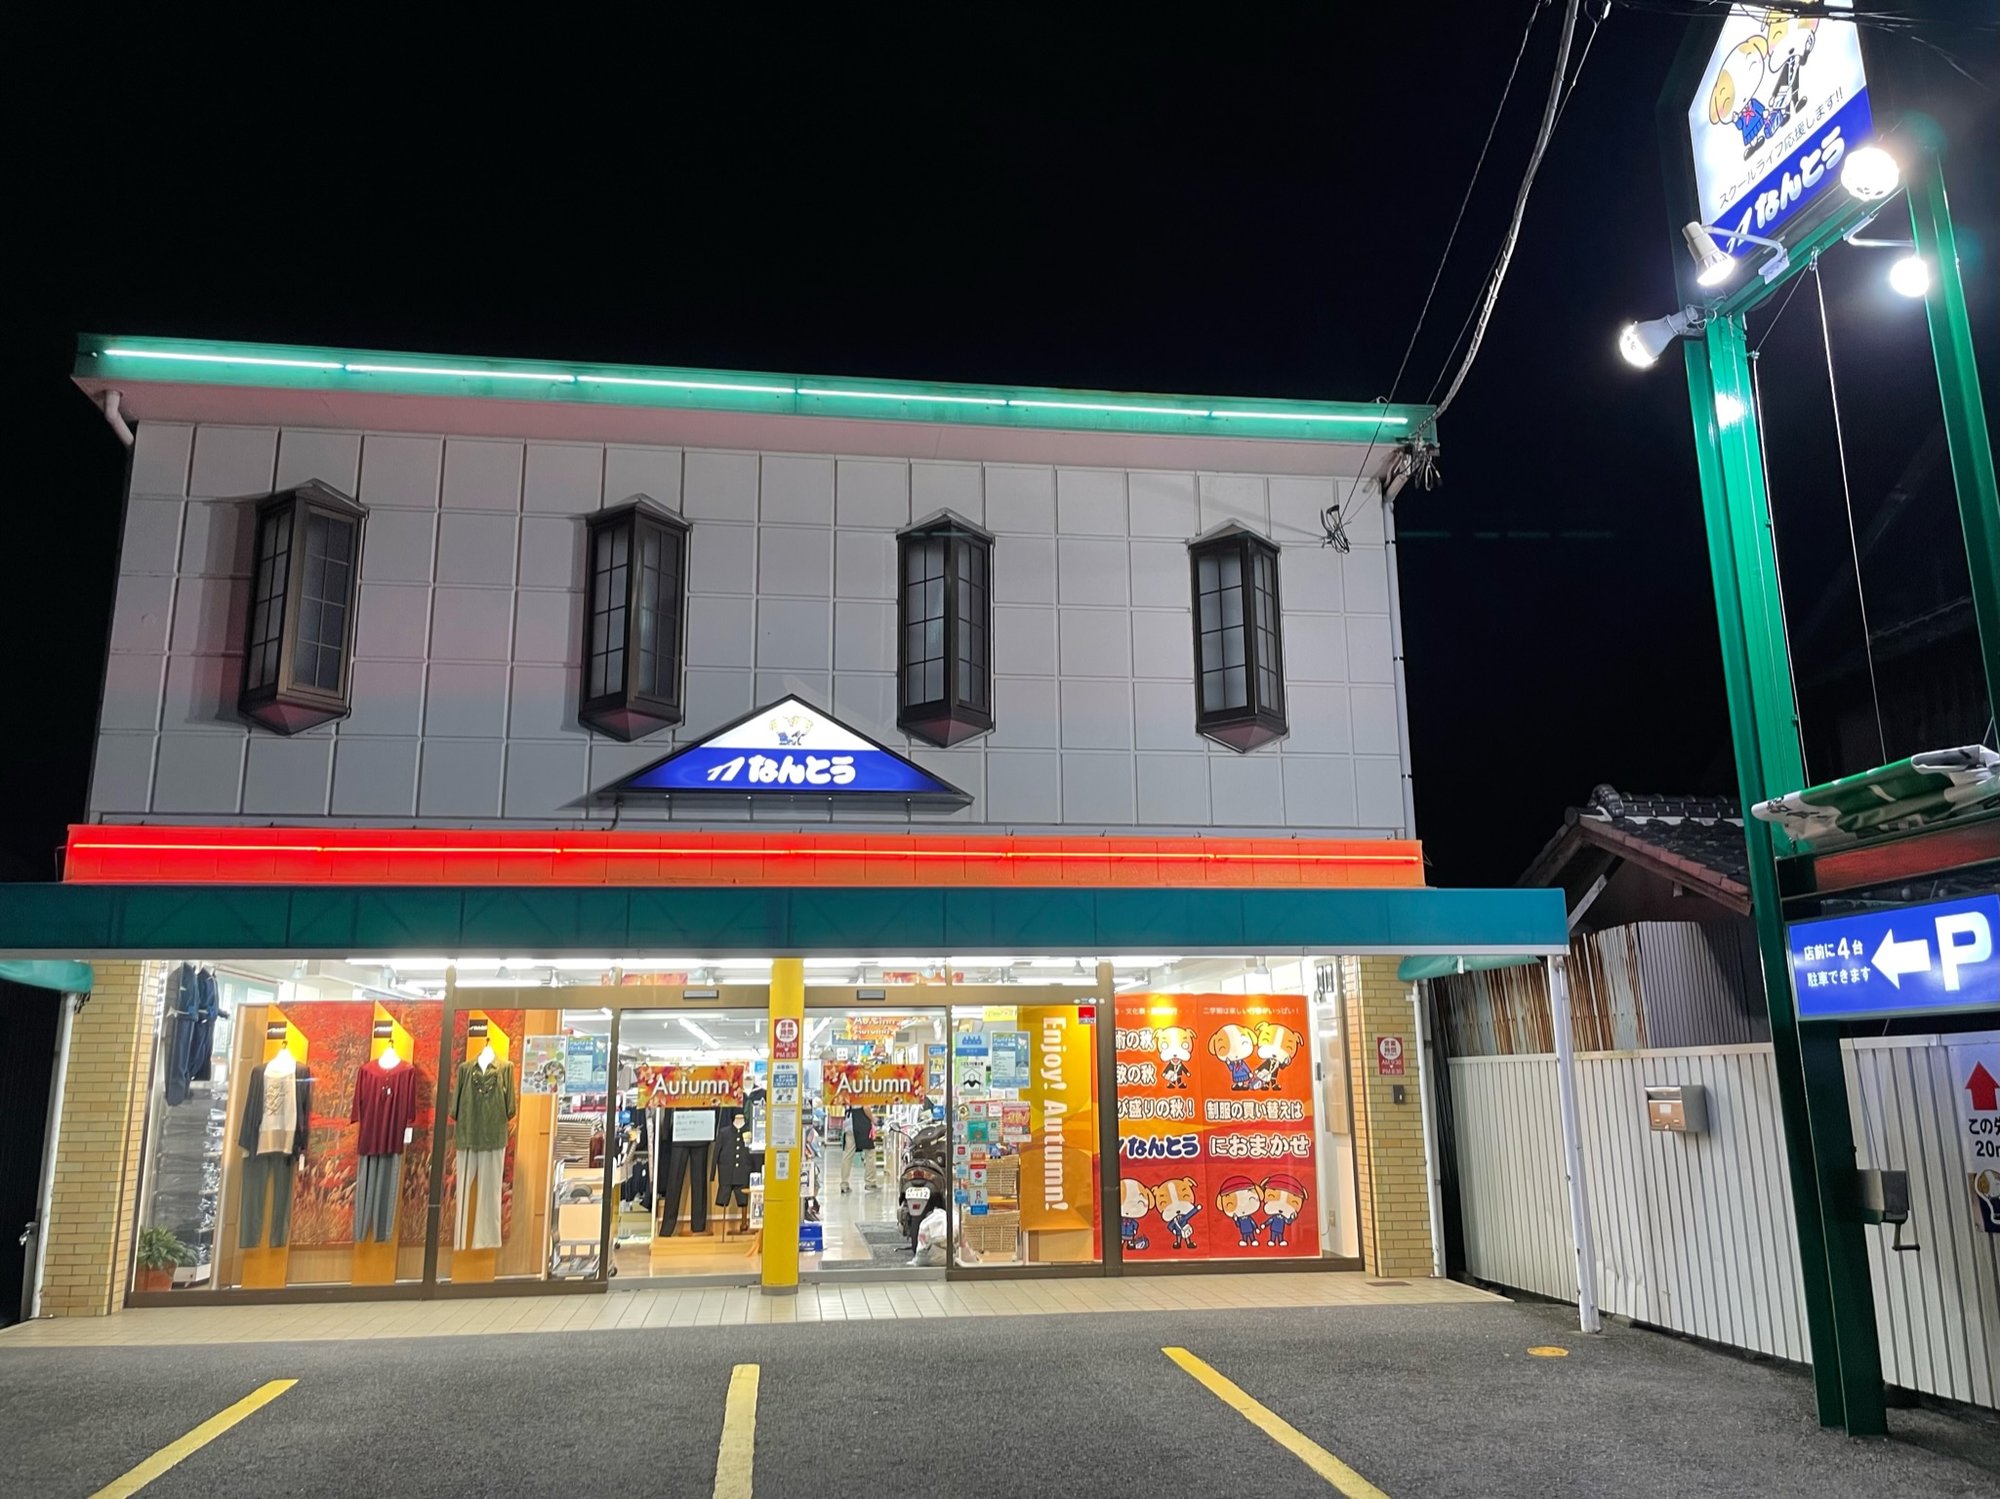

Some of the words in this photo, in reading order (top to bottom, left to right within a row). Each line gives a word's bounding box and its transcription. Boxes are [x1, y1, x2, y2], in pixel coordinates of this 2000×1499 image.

[1935, 911, 1992, 992] P
[1807, 966, 1870, 988] 駐車できます
[1041, 1017, 1067, 1090] Enjoy!
[650, 1073, 730, 1096] Autumn
[836, 1072, 911, 1096] Autumn
[1207, 1101, 1303, 1120] 制服の買い替えは
[1043, 1099, 1069, 1211] Autumn!
[1211, 1135, 1309, 1156] におまかせ
